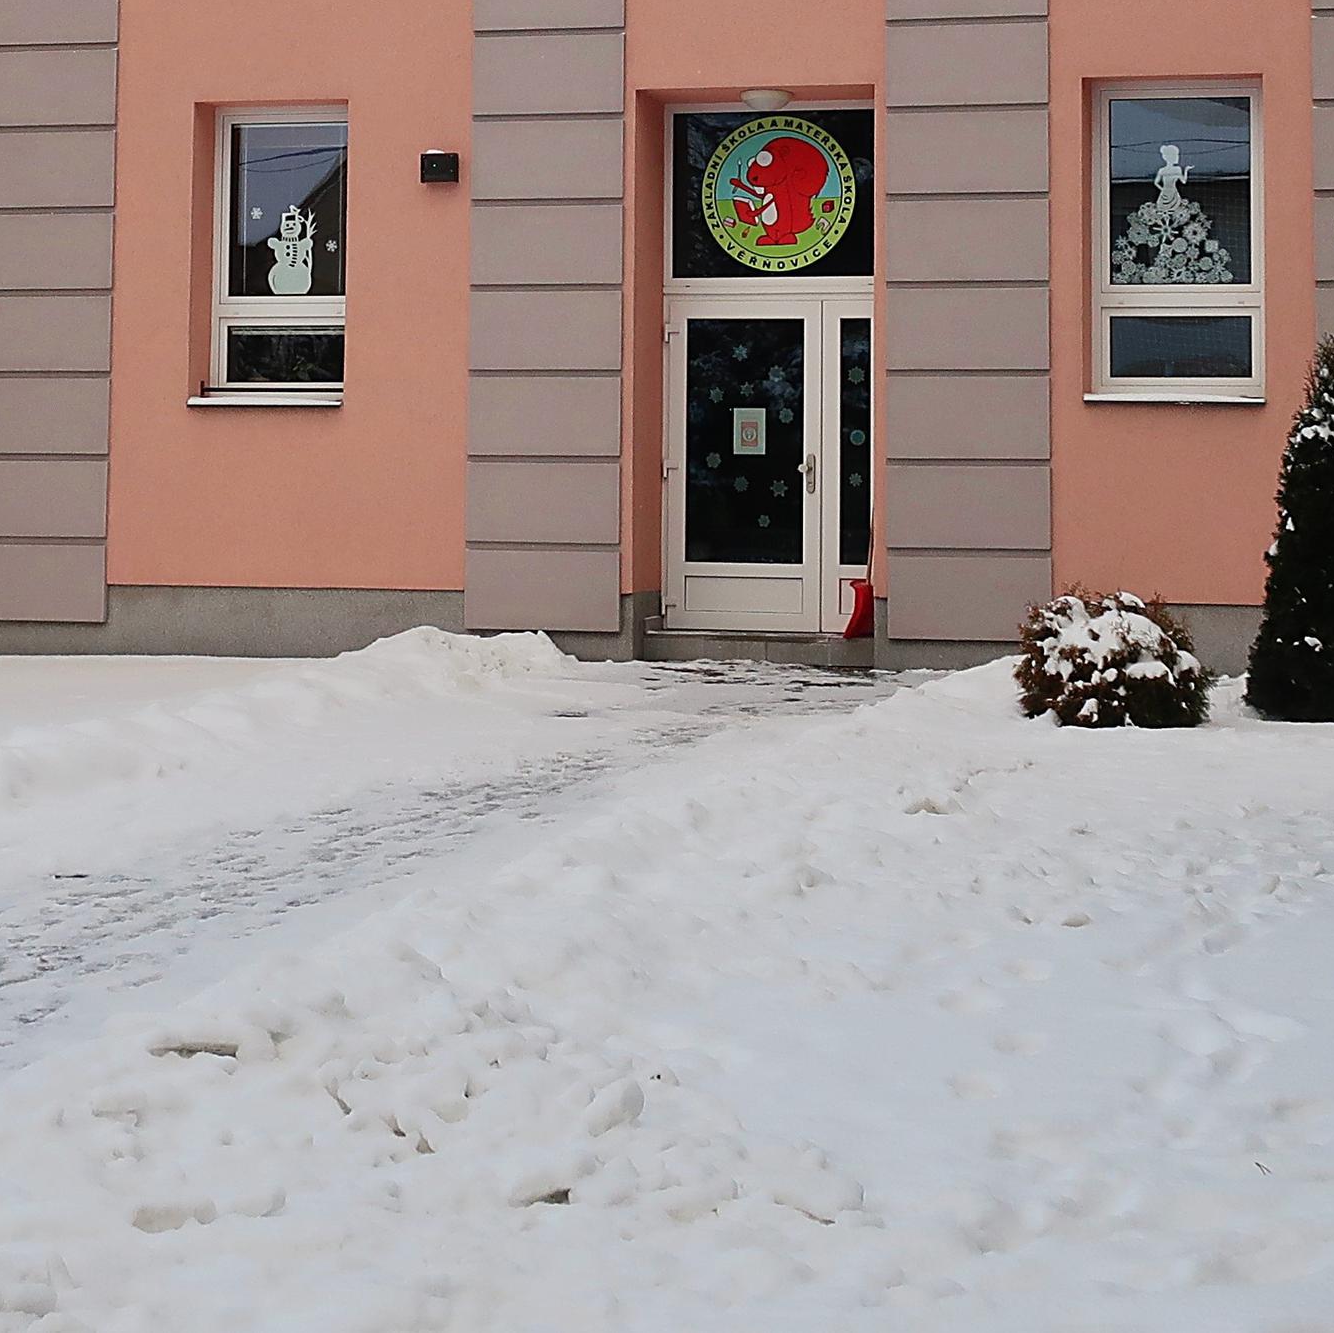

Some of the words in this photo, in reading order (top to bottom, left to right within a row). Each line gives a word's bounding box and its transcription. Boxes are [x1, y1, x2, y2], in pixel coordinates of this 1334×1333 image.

[721, 121, 766, 153] ŠKOLA
[769, 118, 779, 129] A
[838, 175, 853, 224] ŠKOLA
